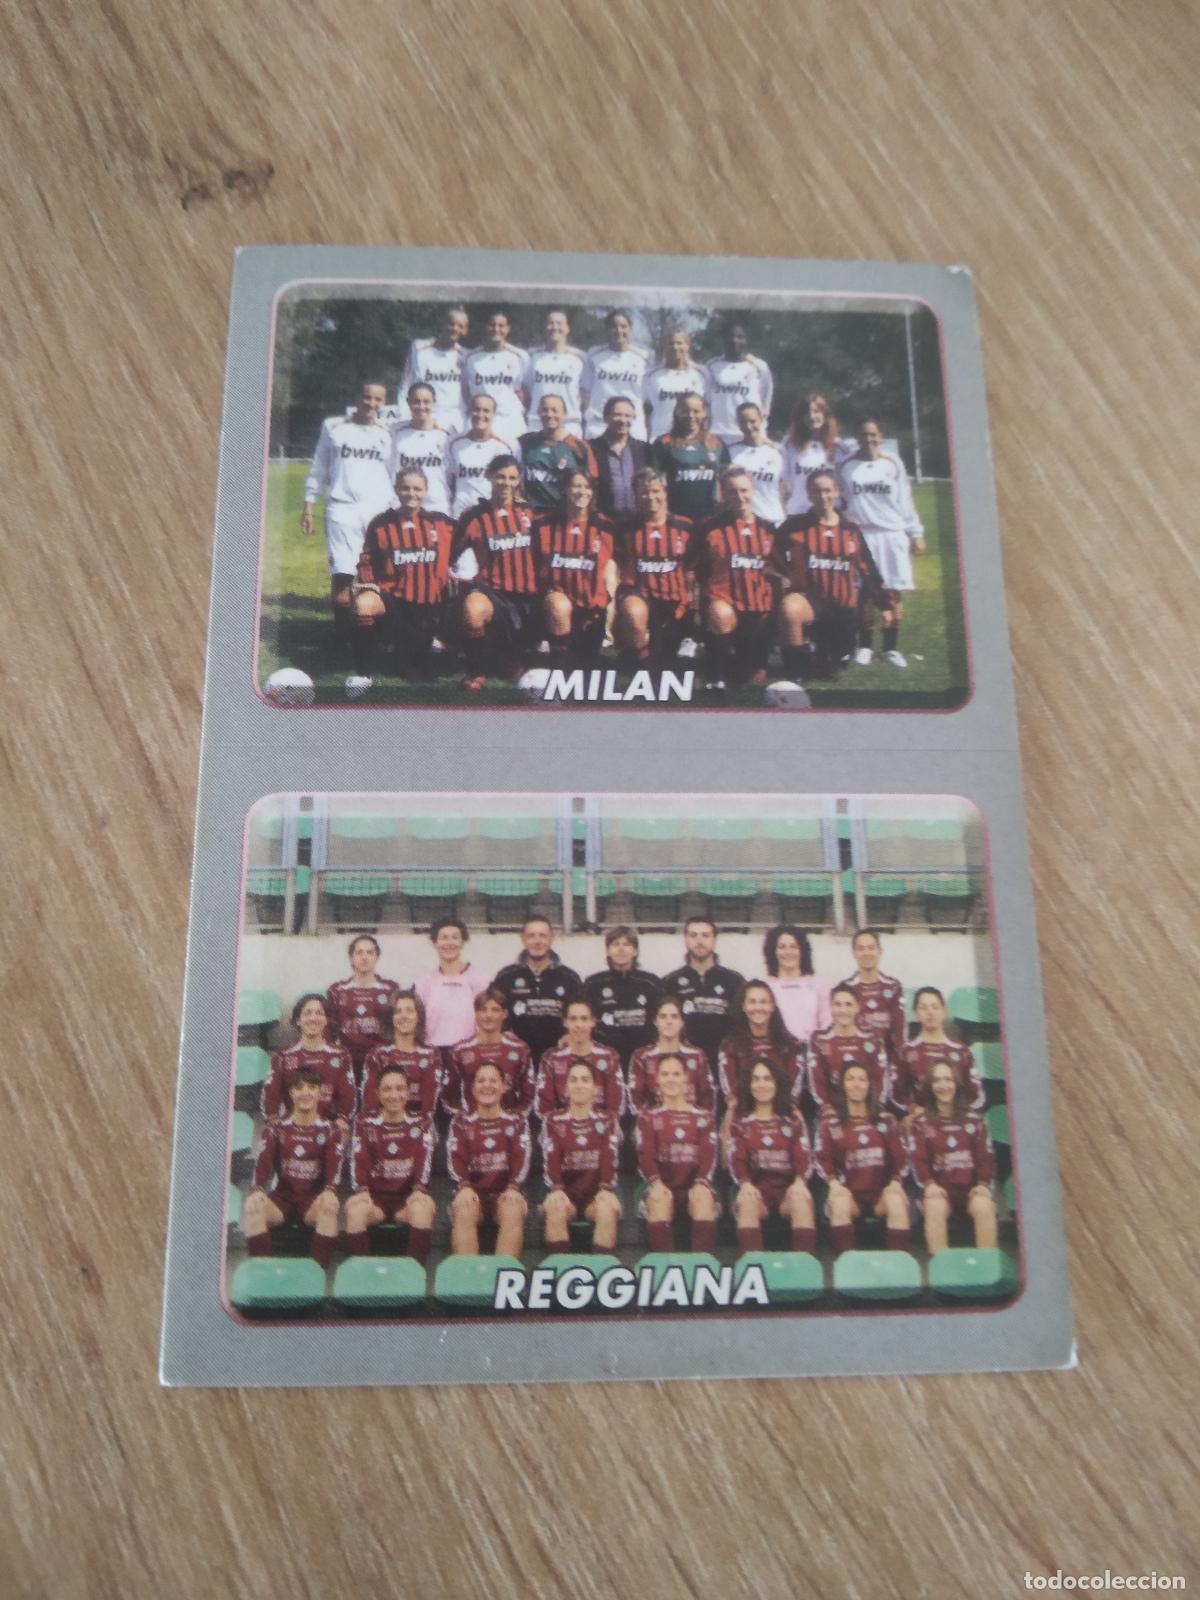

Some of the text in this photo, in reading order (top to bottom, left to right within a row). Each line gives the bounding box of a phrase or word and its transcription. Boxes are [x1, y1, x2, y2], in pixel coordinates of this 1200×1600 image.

[474, 371, 512, 386] bwin
[535, 370, 572, 386] bwin
[598, 369, 638, 386] bwin
[393, 547, 437, 566] bwin
[808, 554, 850, 572] bwin
[544, 669, 695, 701] MILAN
[494, 1265, 770, 1309] REGGIANA
